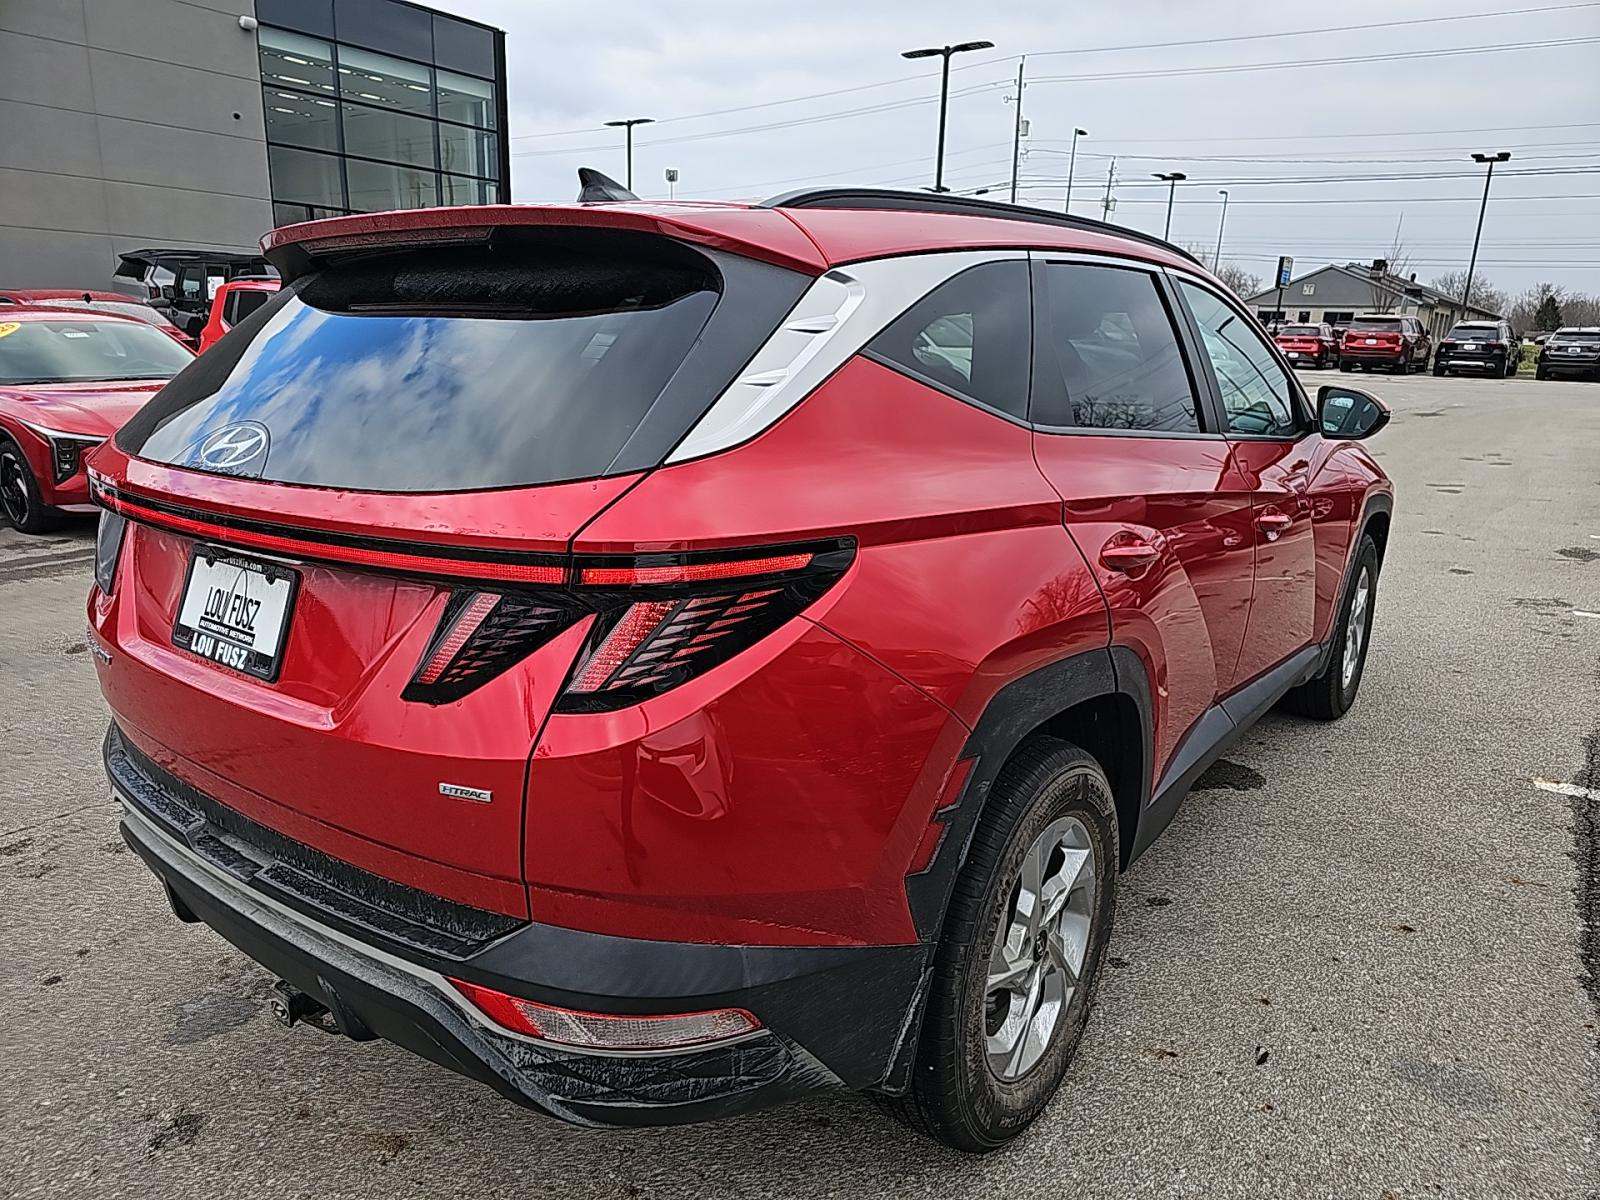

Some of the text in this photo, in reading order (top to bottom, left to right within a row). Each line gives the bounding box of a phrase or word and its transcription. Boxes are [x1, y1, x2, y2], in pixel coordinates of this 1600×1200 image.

[204, 587, 262, 631] LOU FUSZ
[199, 619, 255, 645] AUTOMOTIVE NETWORK
[191, 632, 248, 670] LOU FUSZ
[441, 785, 488, 799] HTRAC
